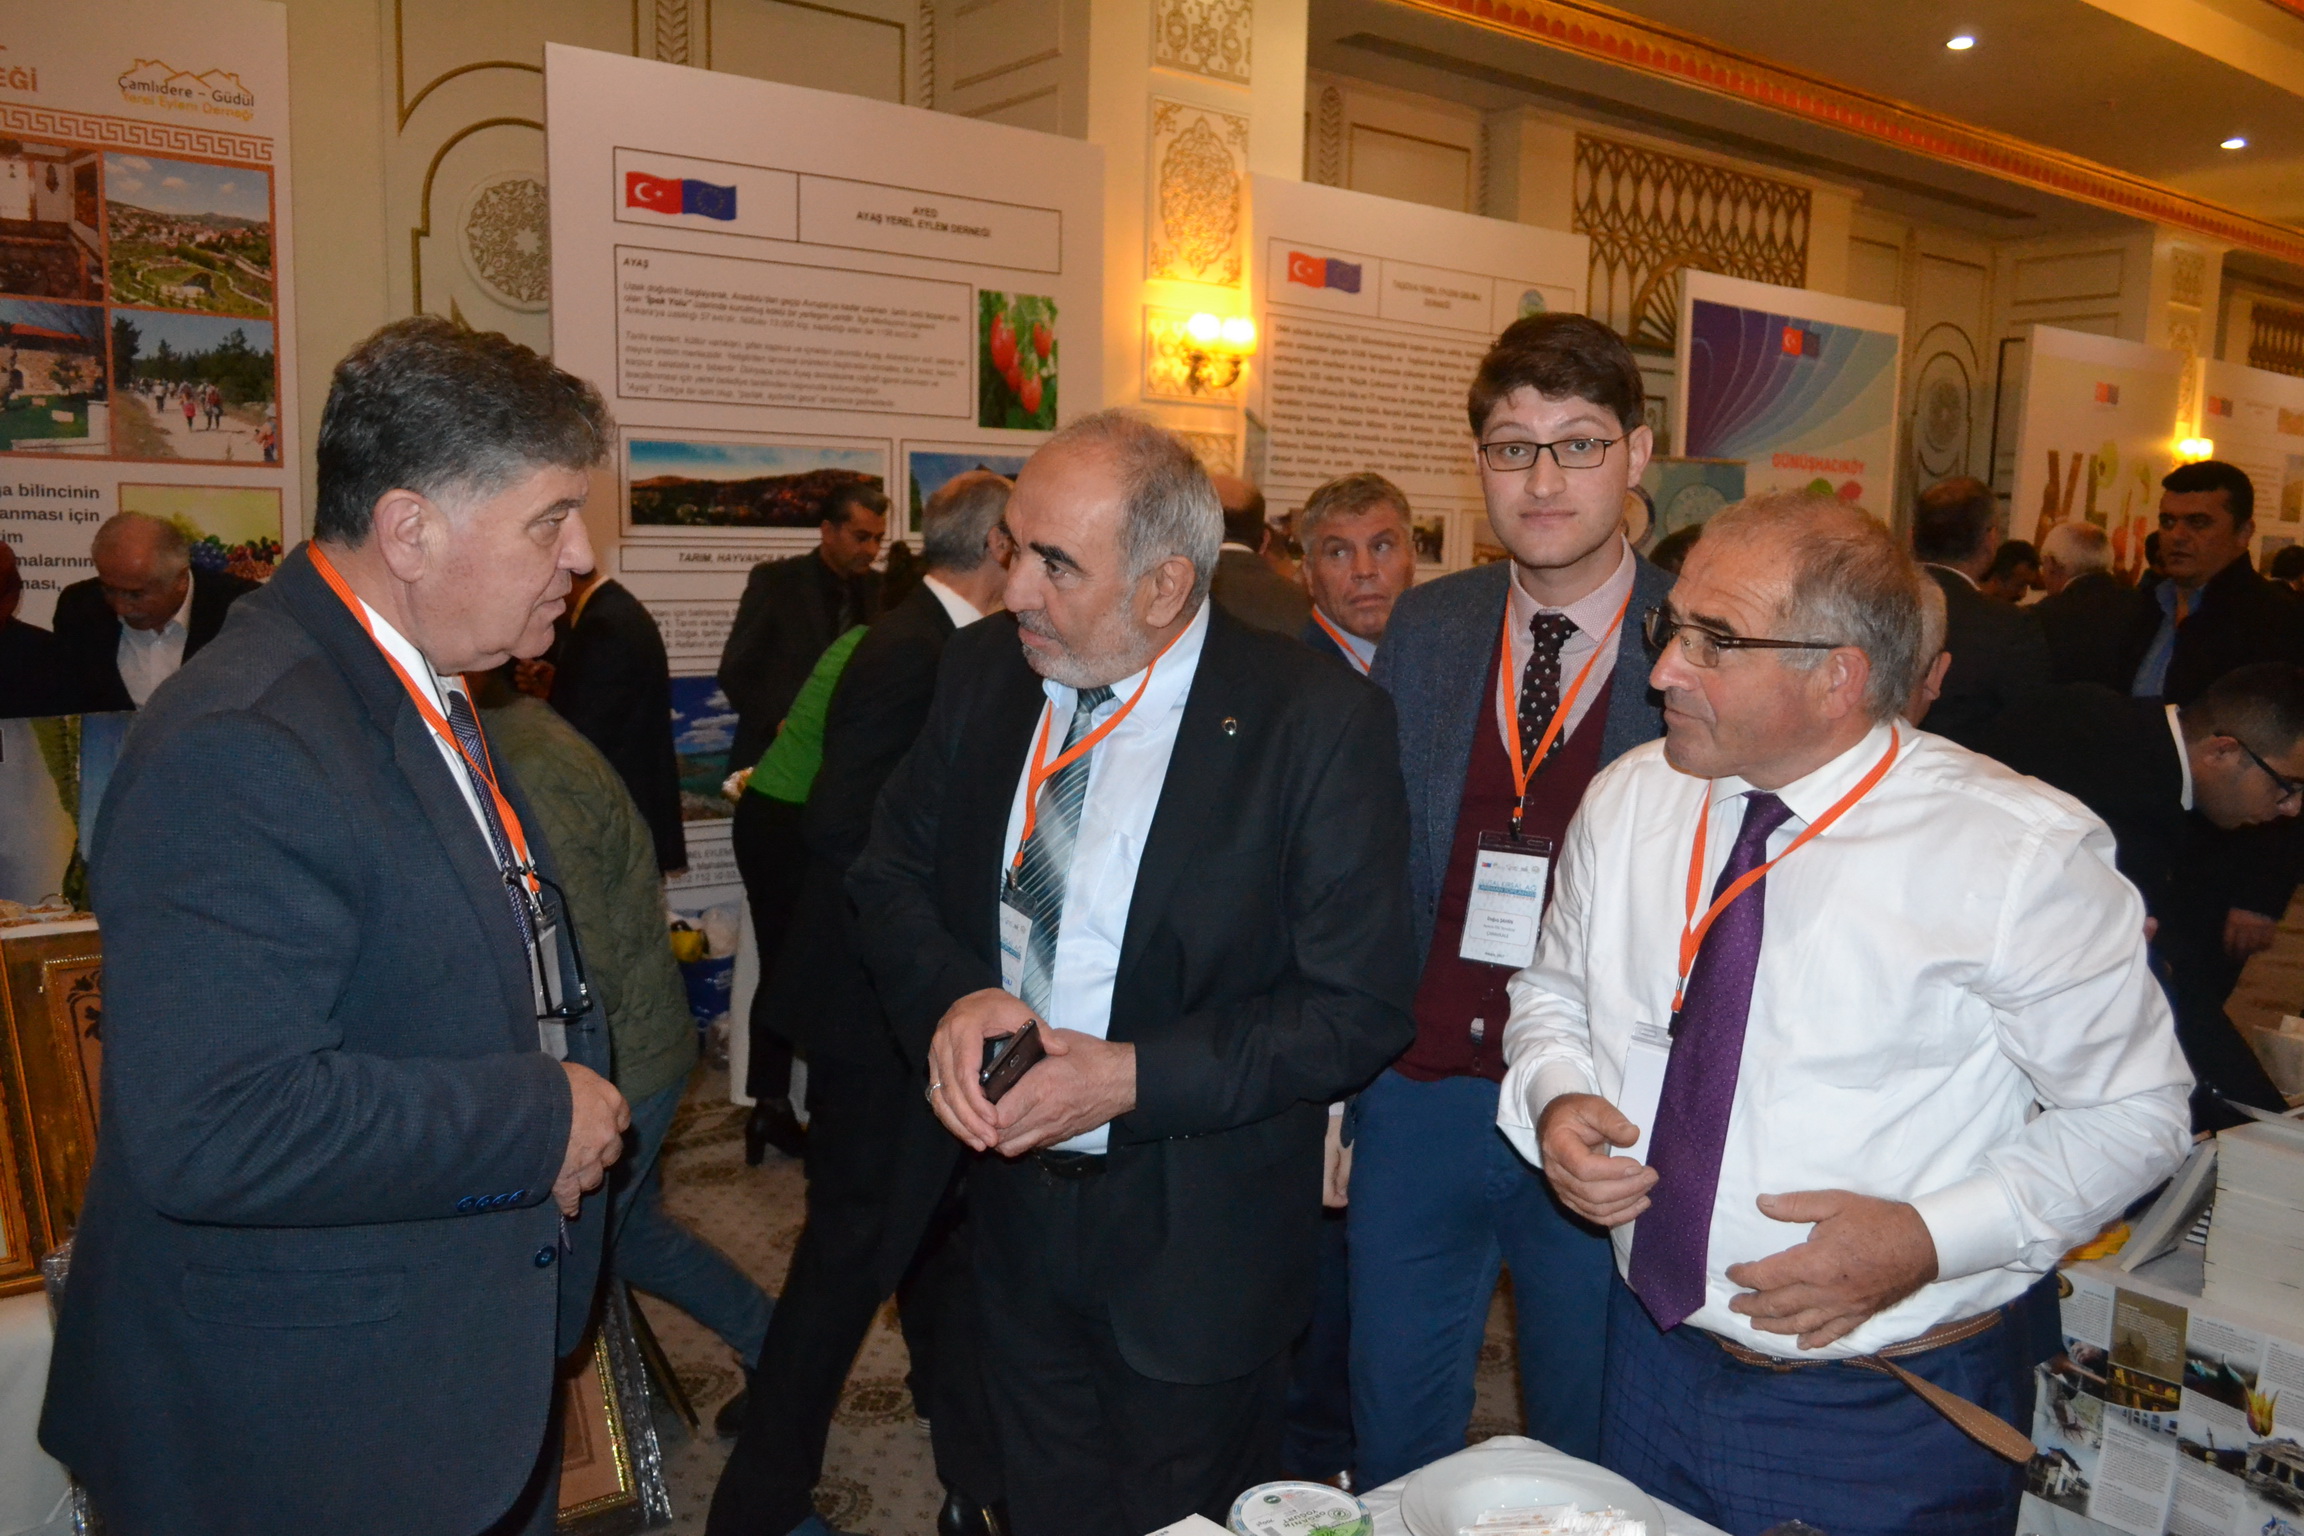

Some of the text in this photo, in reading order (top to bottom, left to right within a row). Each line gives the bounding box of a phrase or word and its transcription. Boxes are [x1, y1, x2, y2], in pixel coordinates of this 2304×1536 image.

[118, 76, 193, 98] Çamlıdere
[212, 90, 254, 106] Güdül
[912, 206, 938, 218] AYED
[856, 211, 882, 225] AYAŞ
[885, 215, 914, 227] YEREL
[918, 219, 948, 232] EYLEM
[623, 257, 649, 269] AYAŞ
[19, 484, 100, 499] bilincinin
[69, 508, 100, 524] için
[680, 552, 713, 563] TARIM,
